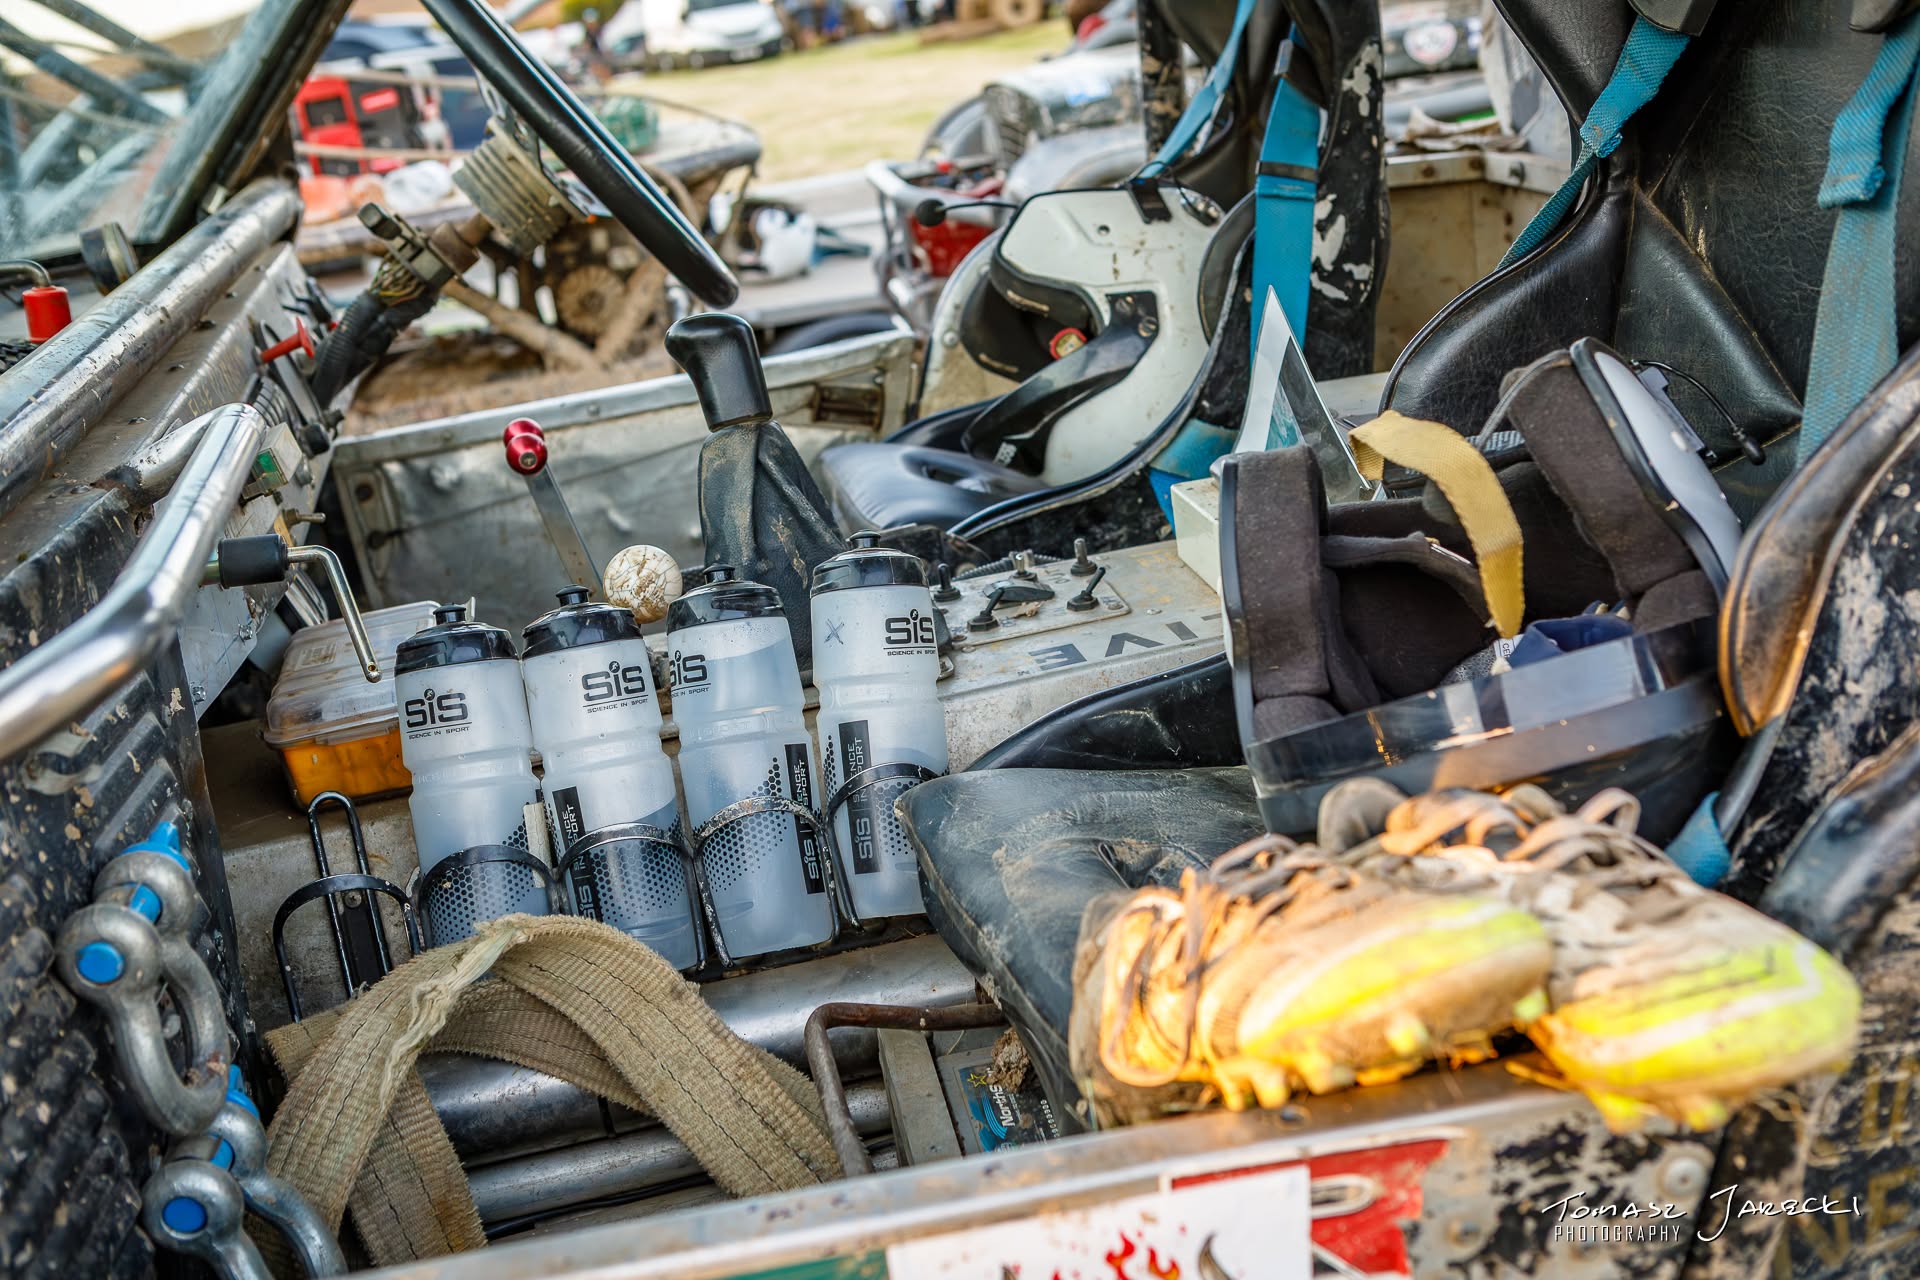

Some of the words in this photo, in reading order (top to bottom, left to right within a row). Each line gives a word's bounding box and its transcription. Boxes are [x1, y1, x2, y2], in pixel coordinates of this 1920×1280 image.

[688, 686, 710, 695] SPORT
[587, 703, 618, 714] SCIENCE
[631, 698, 648, 706] SPORT
[445, 726, 470, 734] SPORT
